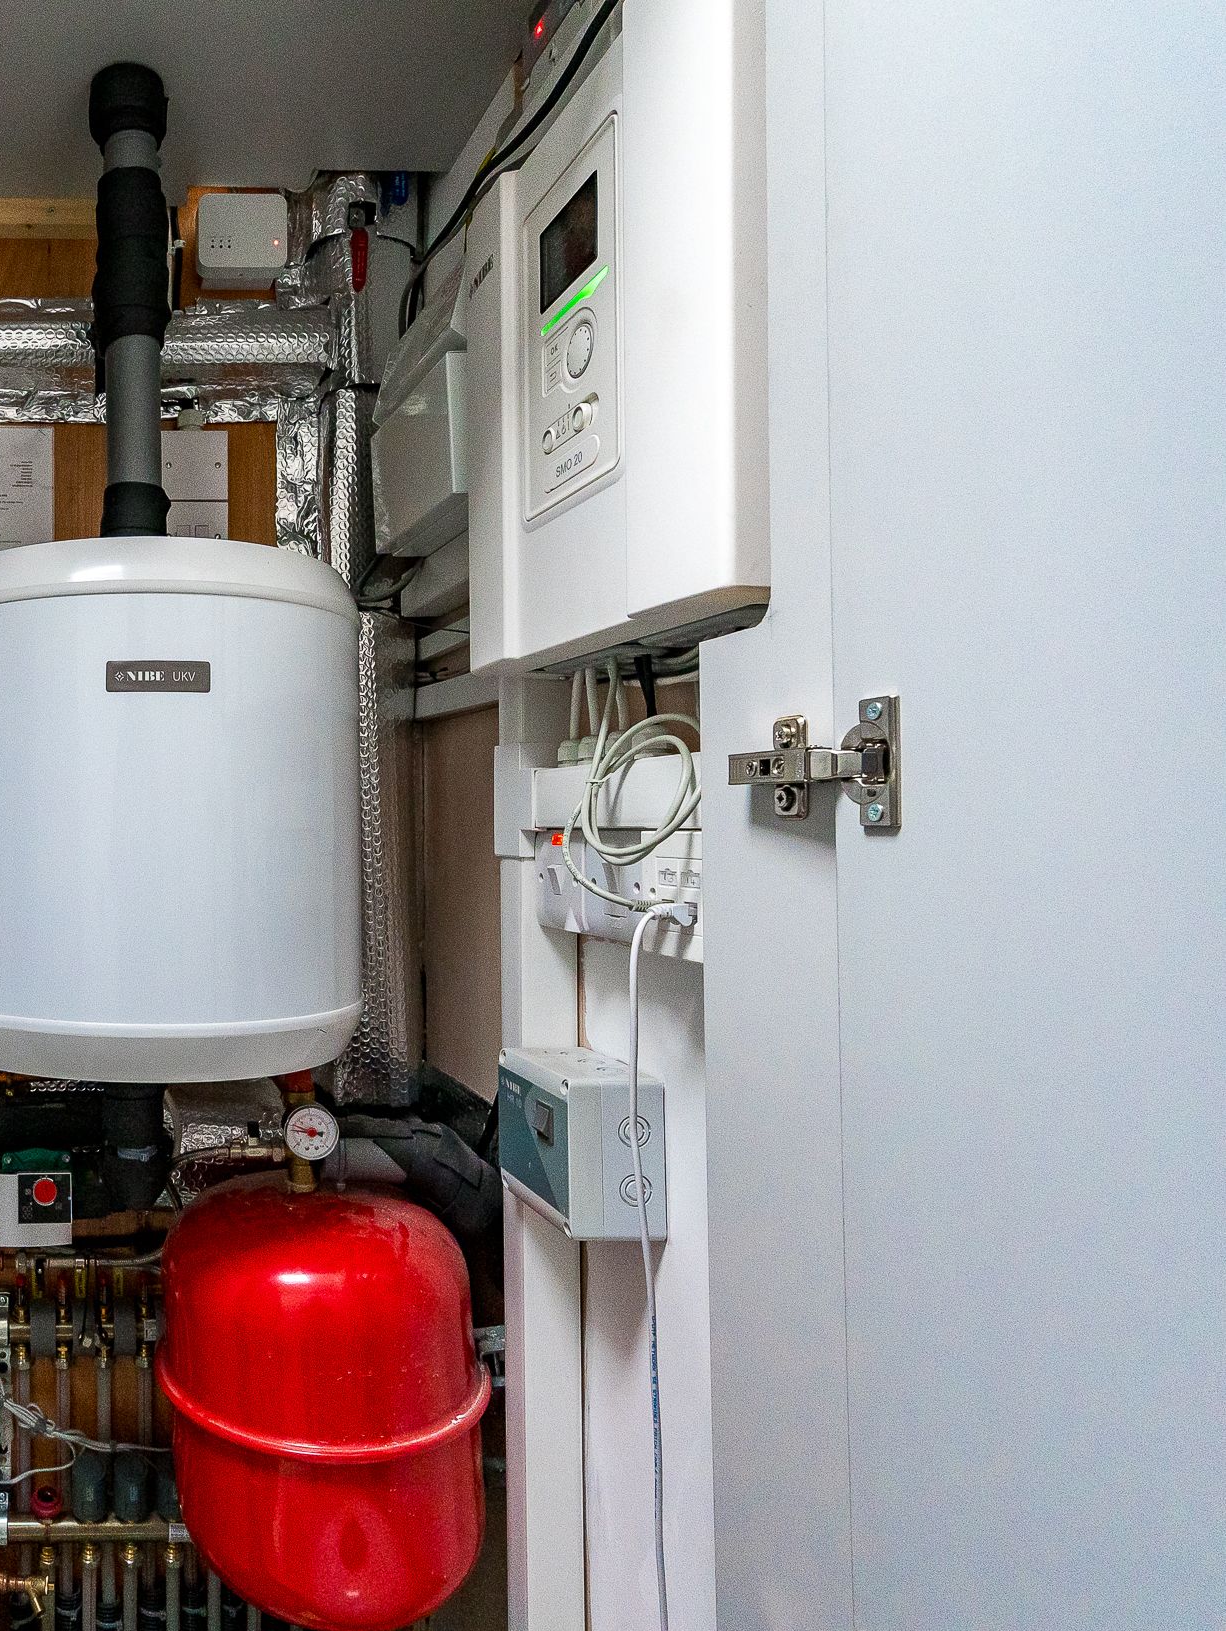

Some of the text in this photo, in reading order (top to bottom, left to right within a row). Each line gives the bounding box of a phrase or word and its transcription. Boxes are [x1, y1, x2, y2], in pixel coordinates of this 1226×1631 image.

[550, 343, 559, 356] OK
[555, 451, 583, 478] SMO 20
[126, 671, 196, 682] NIBE UKV
